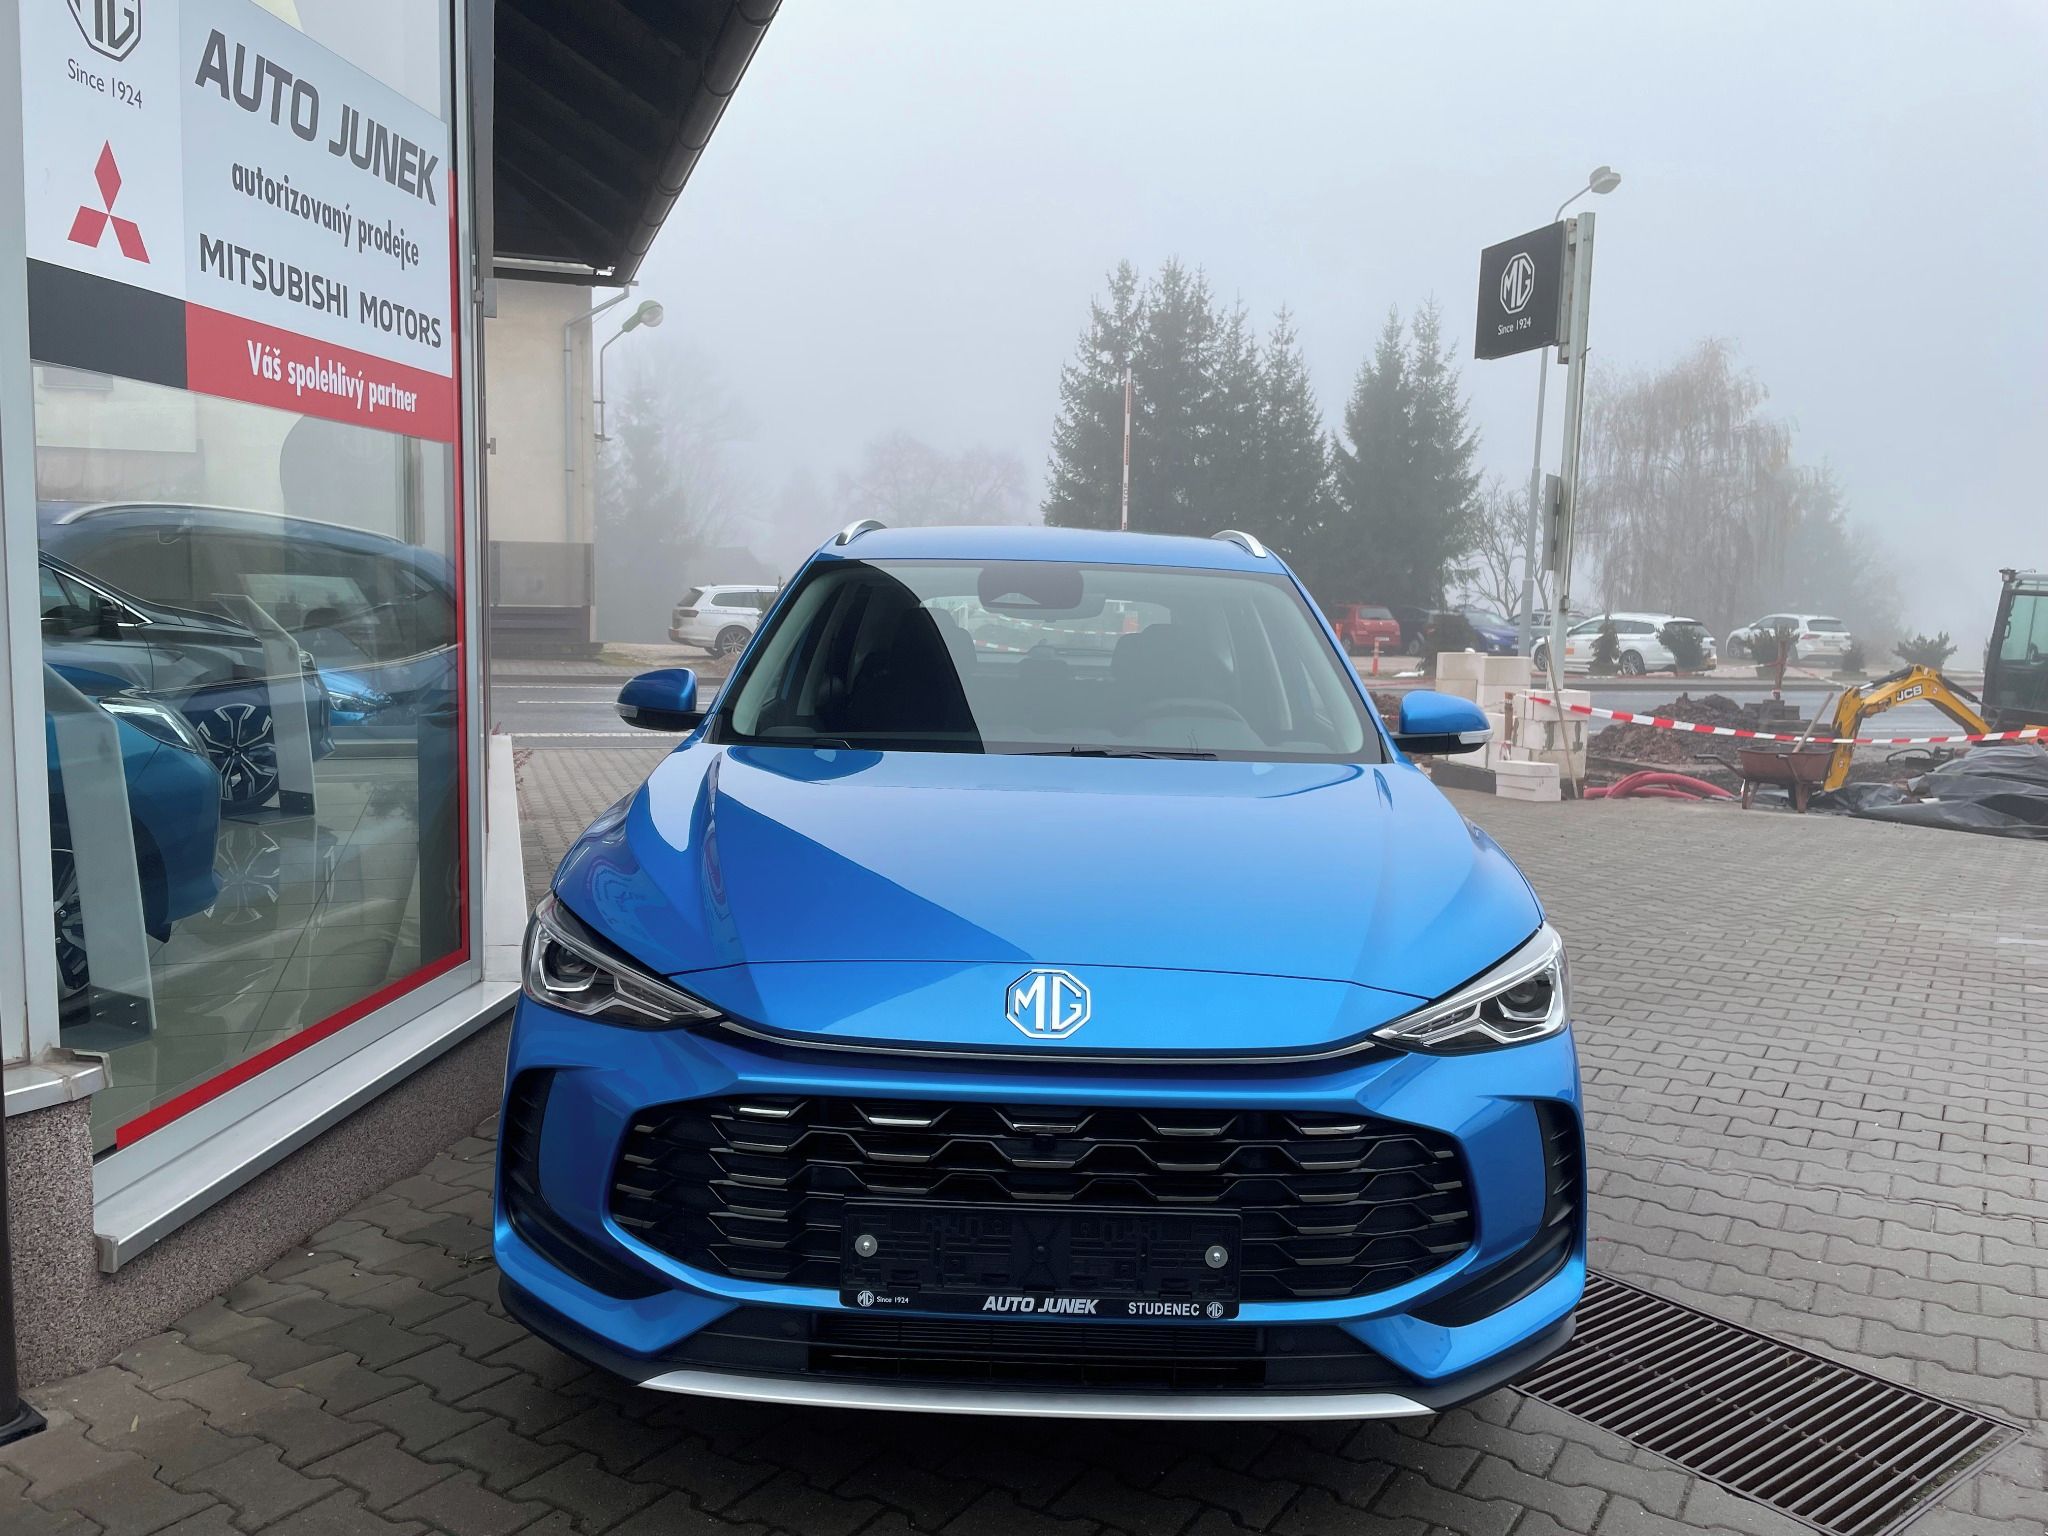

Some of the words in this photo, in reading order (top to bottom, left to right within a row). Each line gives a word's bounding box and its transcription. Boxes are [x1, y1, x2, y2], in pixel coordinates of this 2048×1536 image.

[67, 58, 105, 92] Since
[112, 77, 142, 109] 1924
[195, 28, 320, 142] AUTO
[328, 103, 439, 207] JUNEK
[231, 162, 352, 247] autorizovaný
[357, 219, 419, 271] prodejce
[199, 232, 348, 319] MITSUBISHI
[359, 291, 442, 348] MOTORS
[1502, 256, 1533, 310] MG
[1497, 324, 1514, 336] Since
[1516, 316, 1532, 331] 1924
[247, 339, 282, 382] Váš
[287, 356, 364, 410] spolehlivý
[368, 381, 418, 412] partner
[1896, 685, 1923, 701] JCB
[1012, 974, 1084, 1033] MG
[858, 1291, 874, 1306] MG
[876, 1295, 892, 1304] Since
[894, 1296, 909, 1304] 1924
[982, 1295, 1035, 1312] AUTO
[1037, 1297, 1100, 1314] JUNEK
[1128, 1301, 1200, 1316] STUDENEC
[1207, 1303, 1223, 1317] MG
